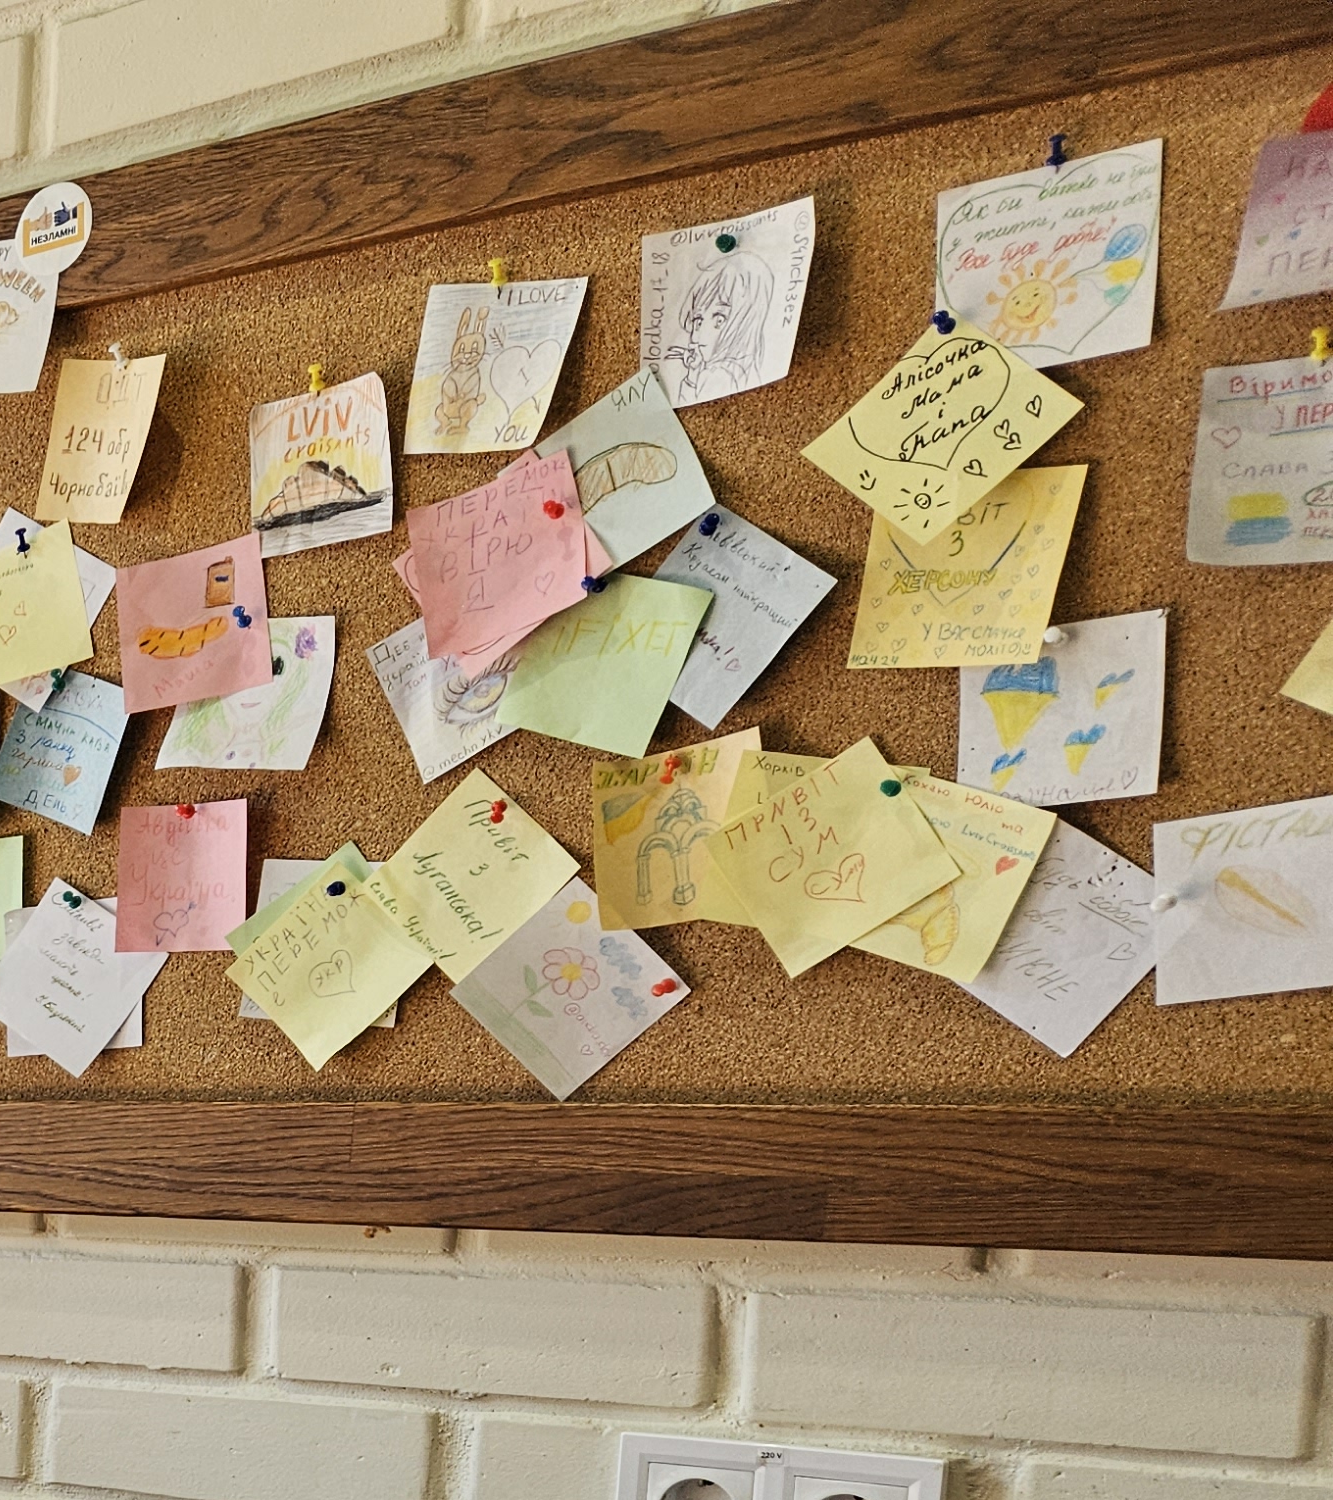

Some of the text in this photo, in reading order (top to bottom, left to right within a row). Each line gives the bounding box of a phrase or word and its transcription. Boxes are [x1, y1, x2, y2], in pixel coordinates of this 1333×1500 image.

[30, 224, 77, 247] НЕЗЛАМНІ
[519, 283, 567, 304] LOVE
[61, 424, 104, 455] 124
[494, 422, 529, 444] YOU
[760, 1450, 775, 1460] 220
